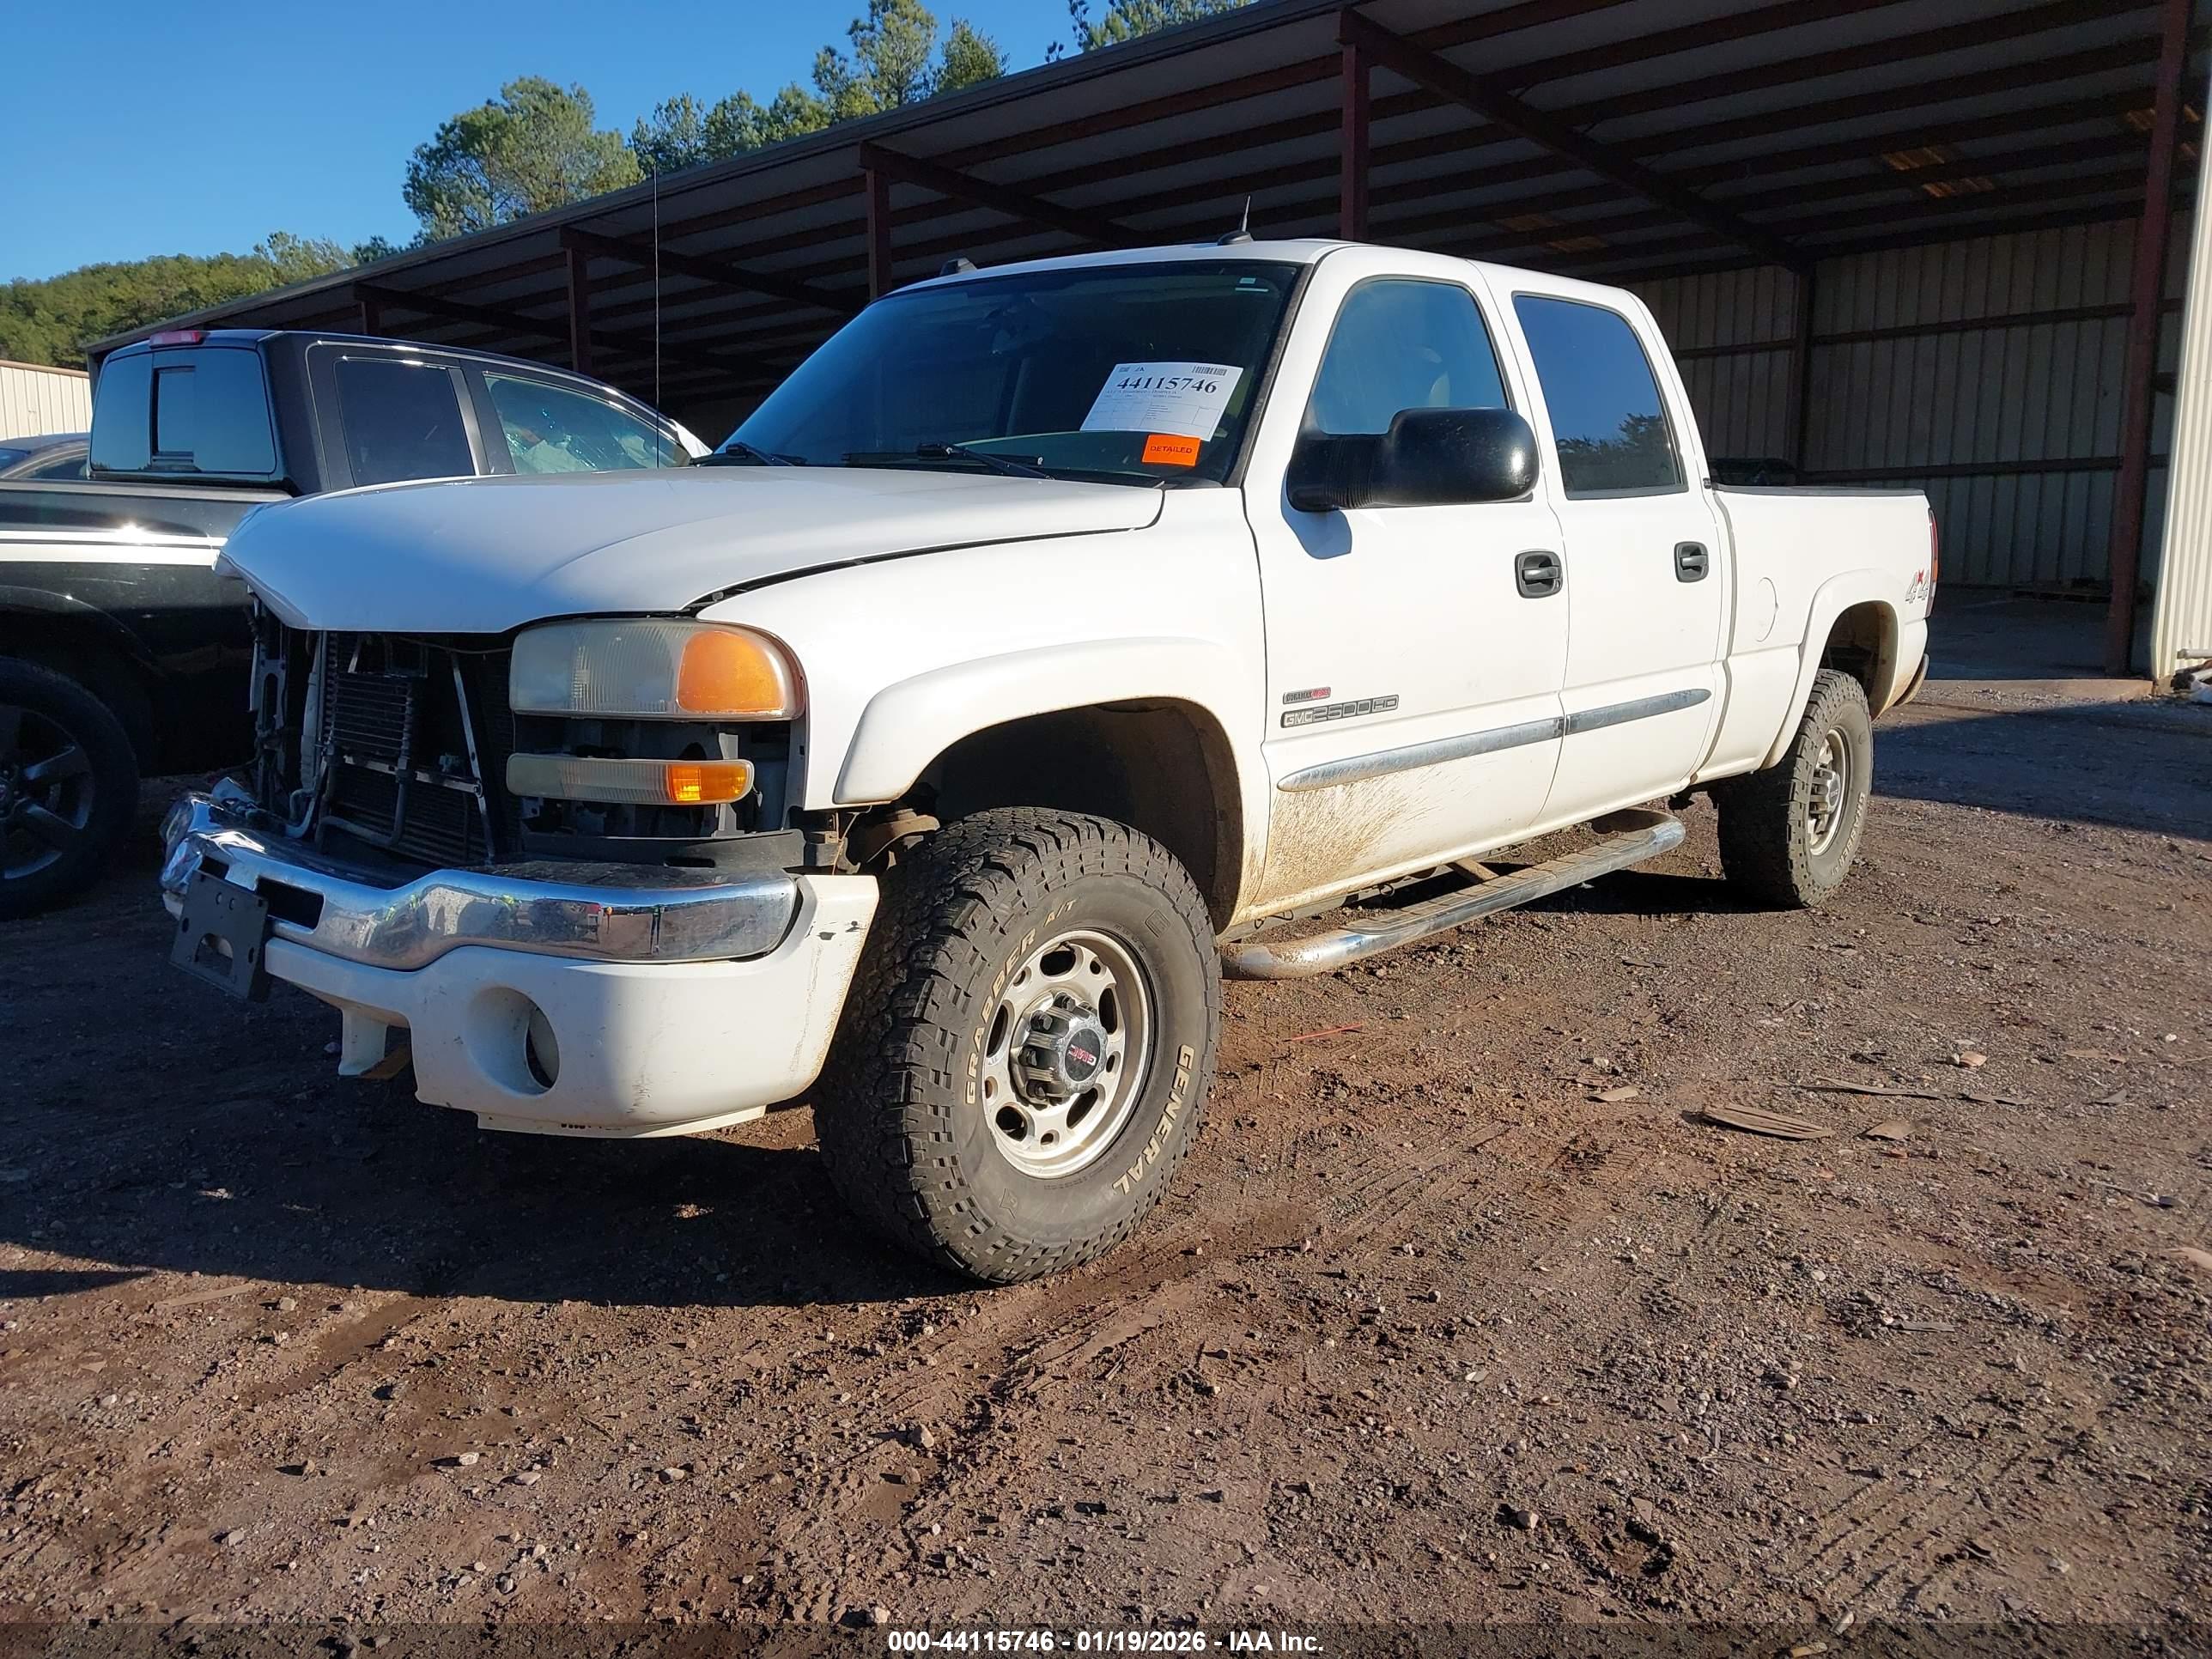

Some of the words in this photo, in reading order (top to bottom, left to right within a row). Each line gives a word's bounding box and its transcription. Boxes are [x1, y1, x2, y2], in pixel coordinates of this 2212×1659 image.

[1117, 376, 1219, 394] 44115746
[1150, 445, 1193, 454] DETAILED
[1285, 690, 1312, 702] DURAMAX
[964, 928, 1036, 1104] GRABBER
[1067, 1043, 1097, 1066] GMC
[1113, 1044, 1195, 1194] GENERAL
